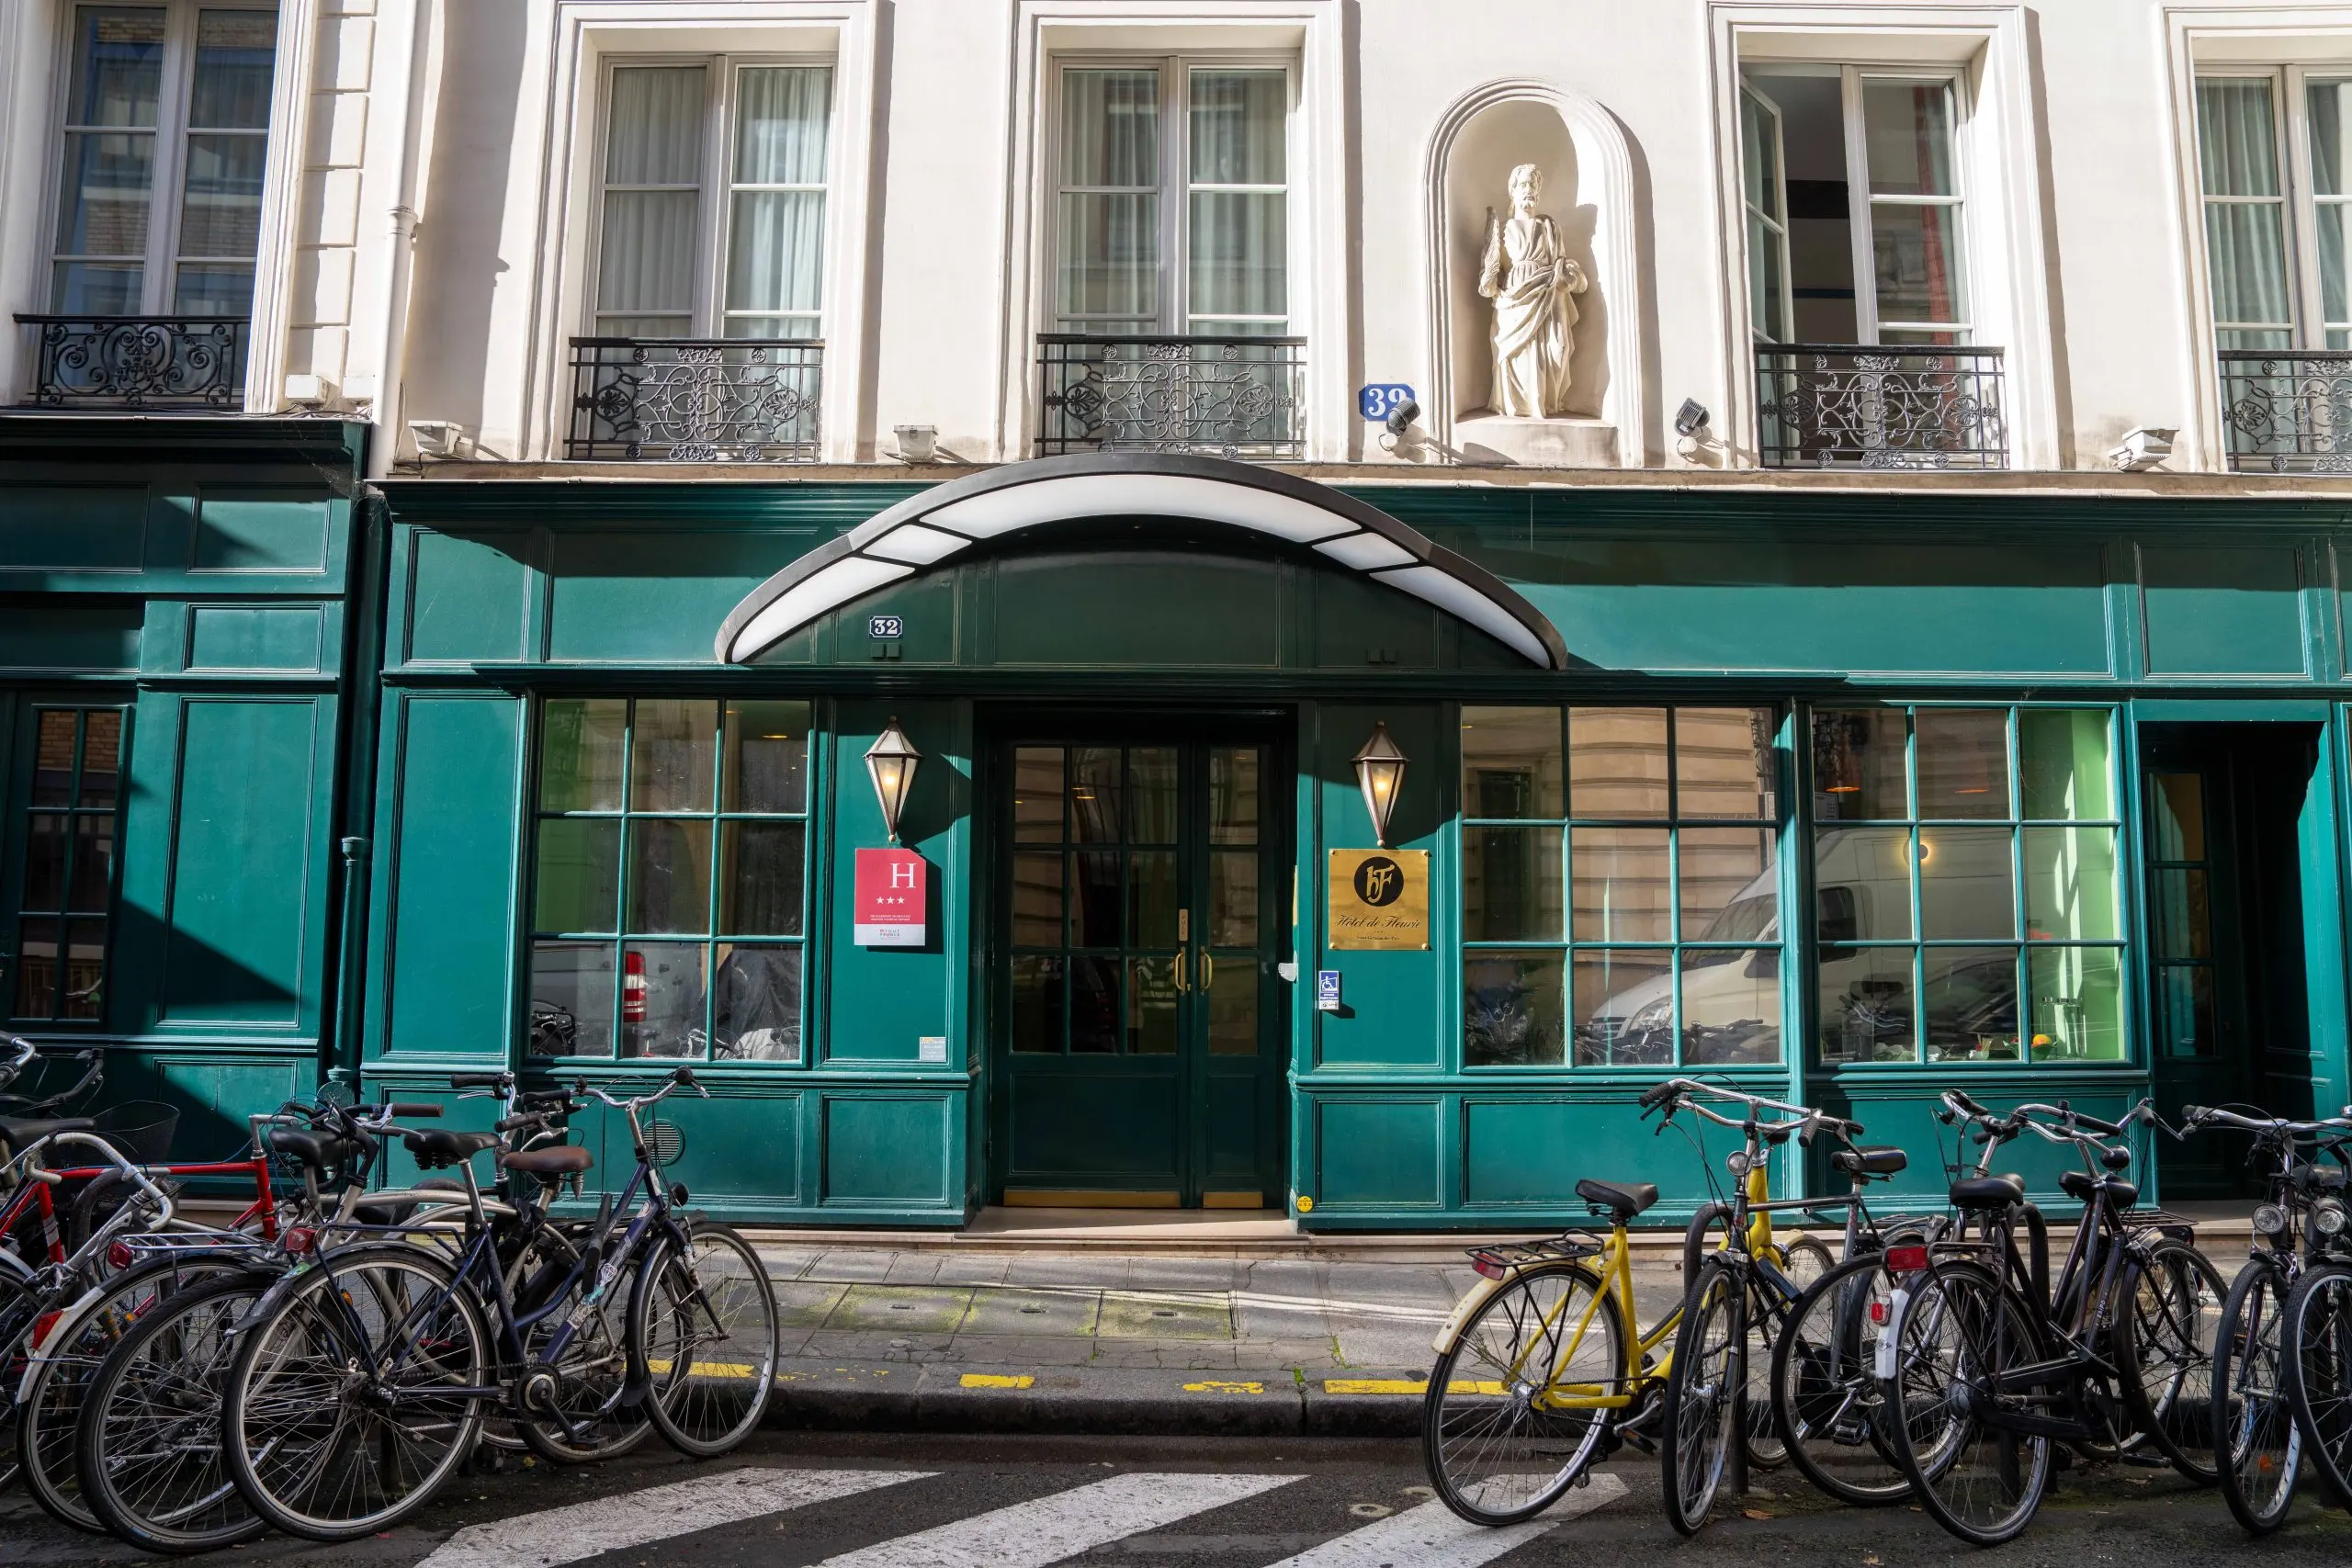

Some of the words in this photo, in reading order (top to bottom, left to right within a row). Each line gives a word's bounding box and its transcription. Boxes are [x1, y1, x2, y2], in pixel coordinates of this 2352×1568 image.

[1368, 388, 1407, 416] 39
[875, 620, 898, 634] 32
[889, 863, 917, 888] H
[1367, 916, 1379, 928] de
